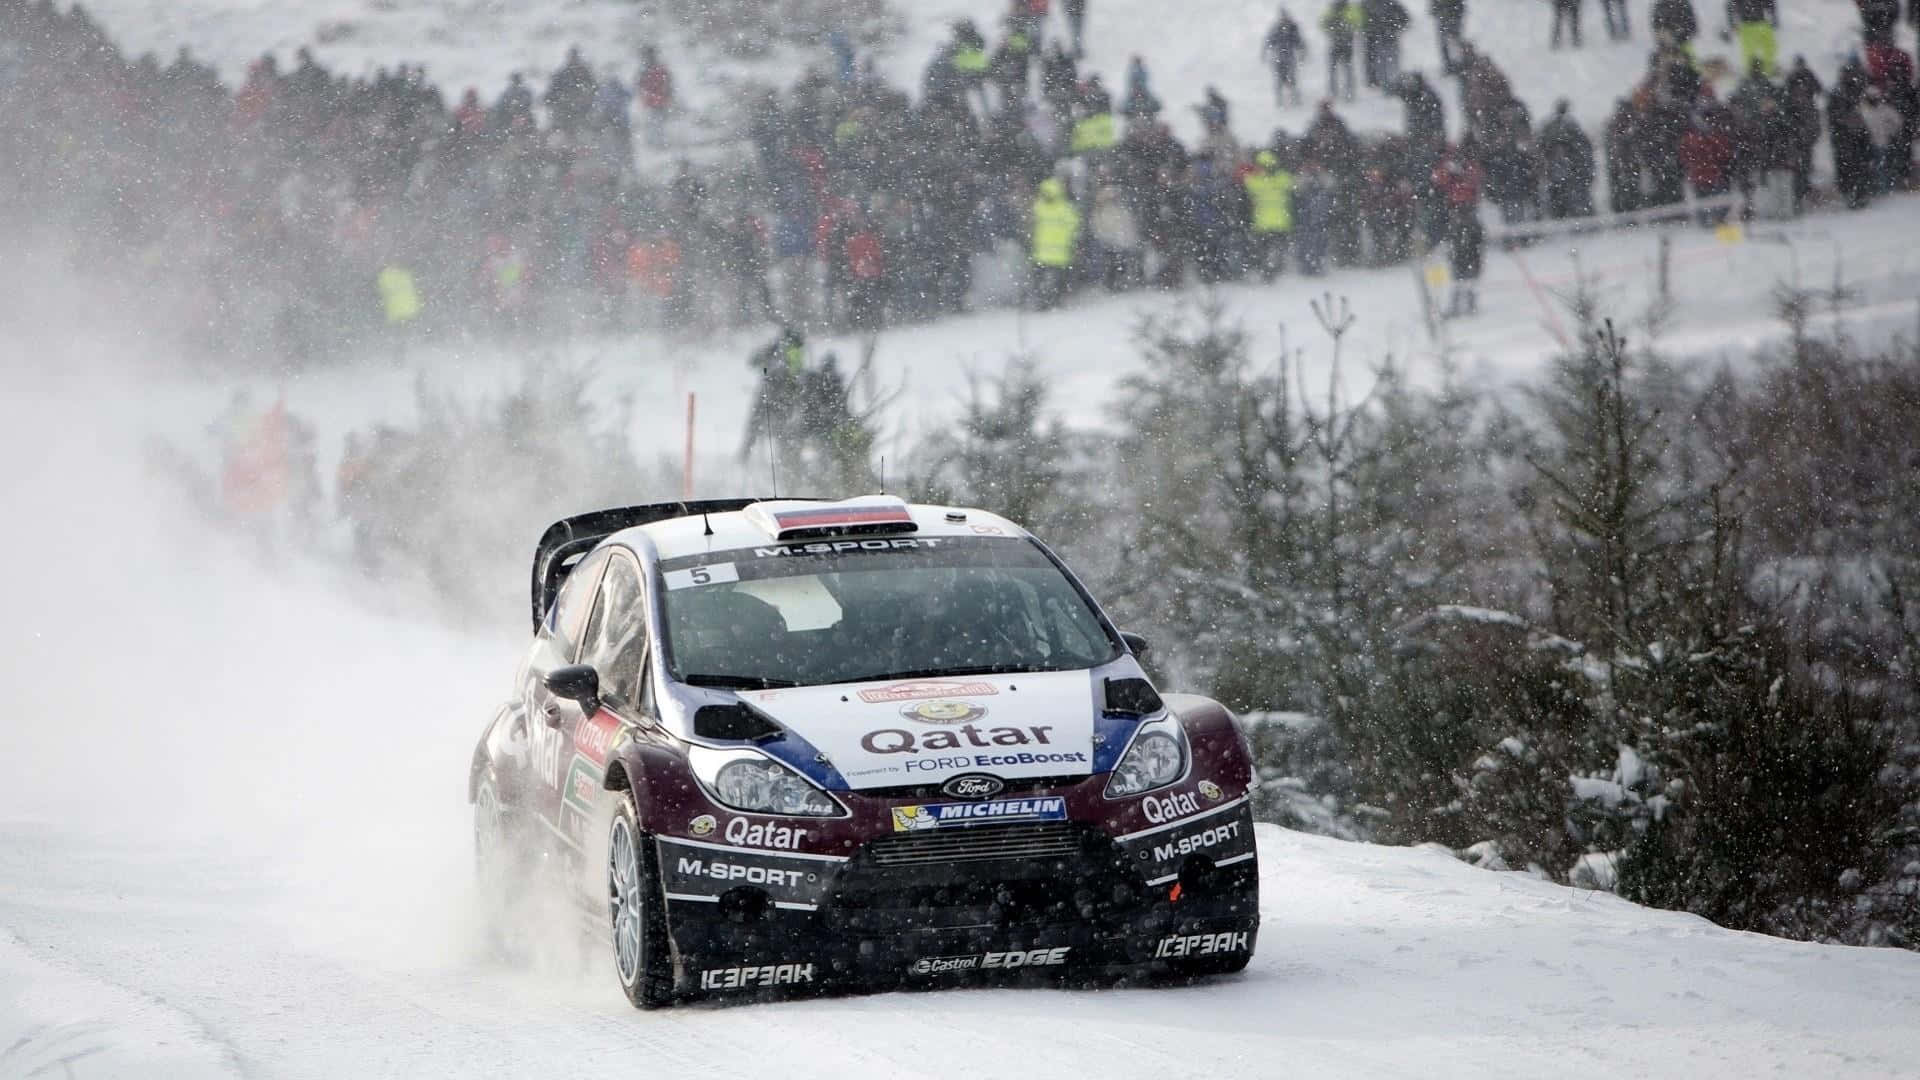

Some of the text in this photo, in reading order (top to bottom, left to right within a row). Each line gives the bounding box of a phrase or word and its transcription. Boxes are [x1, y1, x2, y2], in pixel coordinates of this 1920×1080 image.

[755, 538, 941, 558] M-SPORT
[690, 567, 711, 585] 5
[861, 724, 1053, 755] Qatar
[906, 756, 970, 773] FORD
[976, 751, 1088, 767] EcoBoost
[957, 779, 990, 795] Ford
[939, 800, 1062, 820] MICHELIN
[1142, 790, 1201, 824] Qatar
[725, 817, 807, 850] Qatar
[1153, 820, 1240, 863] M-SPORT
[678, 857, 803, 887] M-SPORT
[931, 946, 1072, 973] Castrol EDGE
